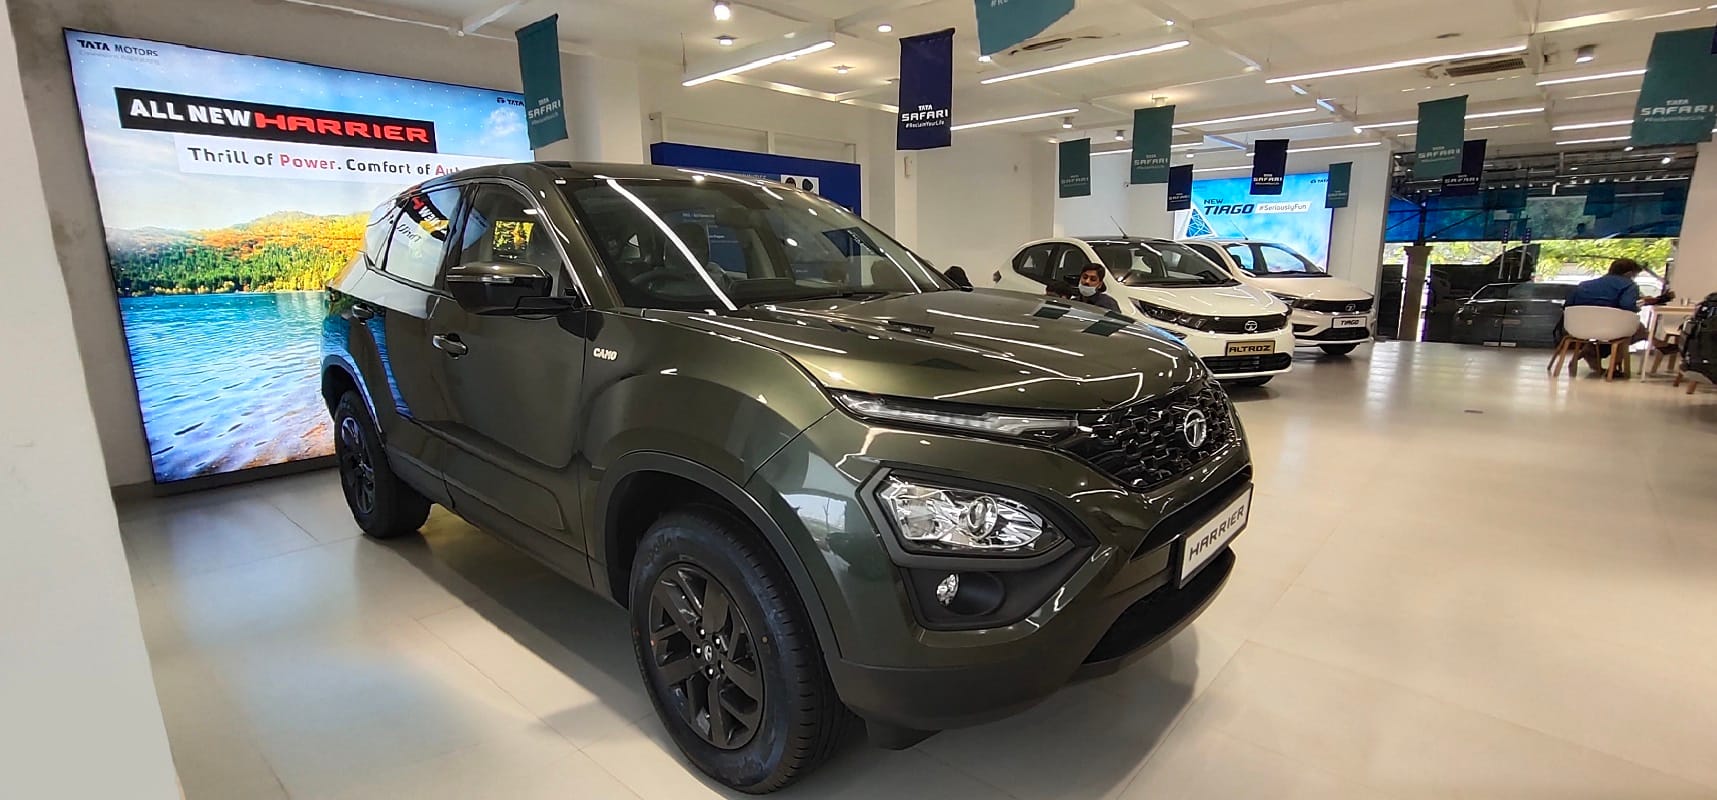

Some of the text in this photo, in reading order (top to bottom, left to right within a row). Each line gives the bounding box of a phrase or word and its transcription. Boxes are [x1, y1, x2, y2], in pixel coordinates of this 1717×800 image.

[77, 40, 158, 56] TATA MOTORS
[528, 100, 561, 119] SAFARI
[901, 109, 949, 122] SAFARI
[1640, 104, 1714, 116] SAFARI
[130, 98, 430, 143] ALL NEW HARRIER
[187, 147, 459, 176] Thrill of Power. Comfort of Au
[1203, 203, 1307, 215] TIAGO #SeriouslyFun
[593, 347, 618, 361] CAMO
[1229, 345, 1271, 353] ALTROZ
[1189, 505, 1245, 561] HARRIER
